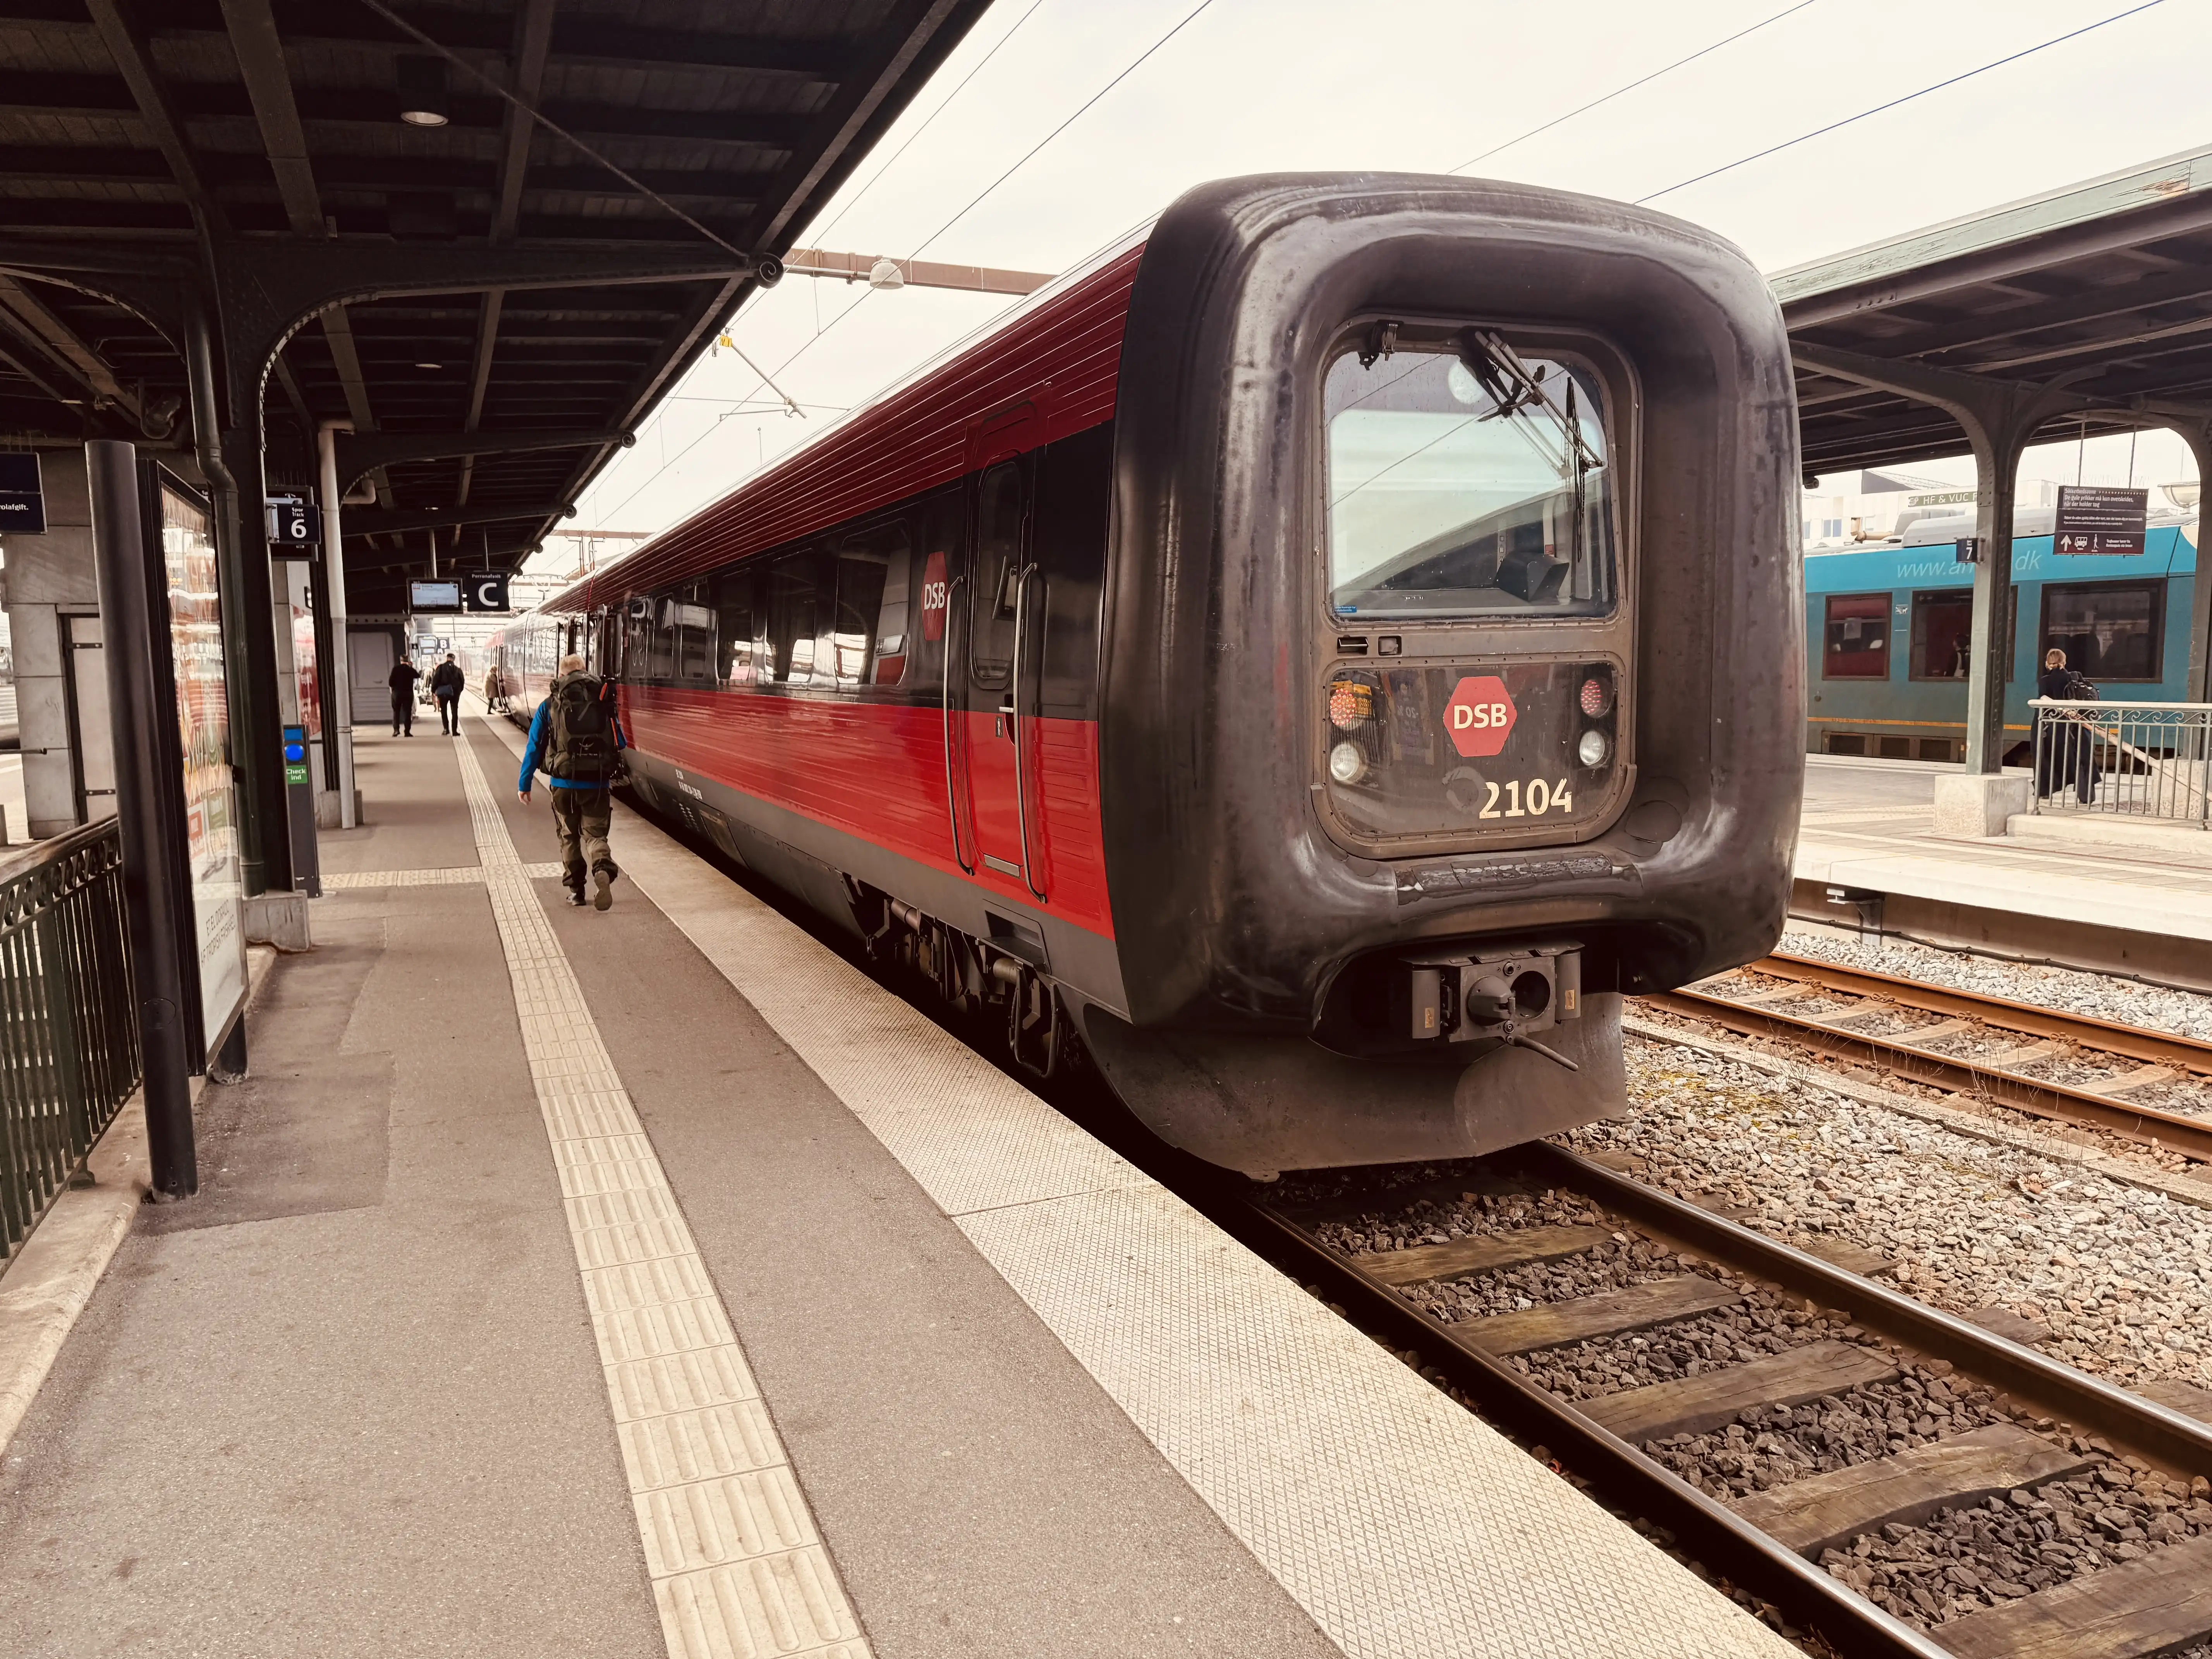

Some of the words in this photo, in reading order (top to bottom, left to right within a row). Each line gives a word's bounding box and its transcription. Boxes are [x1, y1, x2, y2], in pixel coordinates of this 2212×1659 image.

[1923, 496, 1935, 505] HF
[1949, 493, 1968, 502] VUC
[291, 519, 307, 538] 6
[1966, 547, 1972, 559] 7
[478, 582, 499, 606] C
[924, 582, 945, 610] DSB
[440, 640, 447, 648] B
[1453, 703, 1507, 729] DSB
[1479, 778, 1572, 819] 2104
